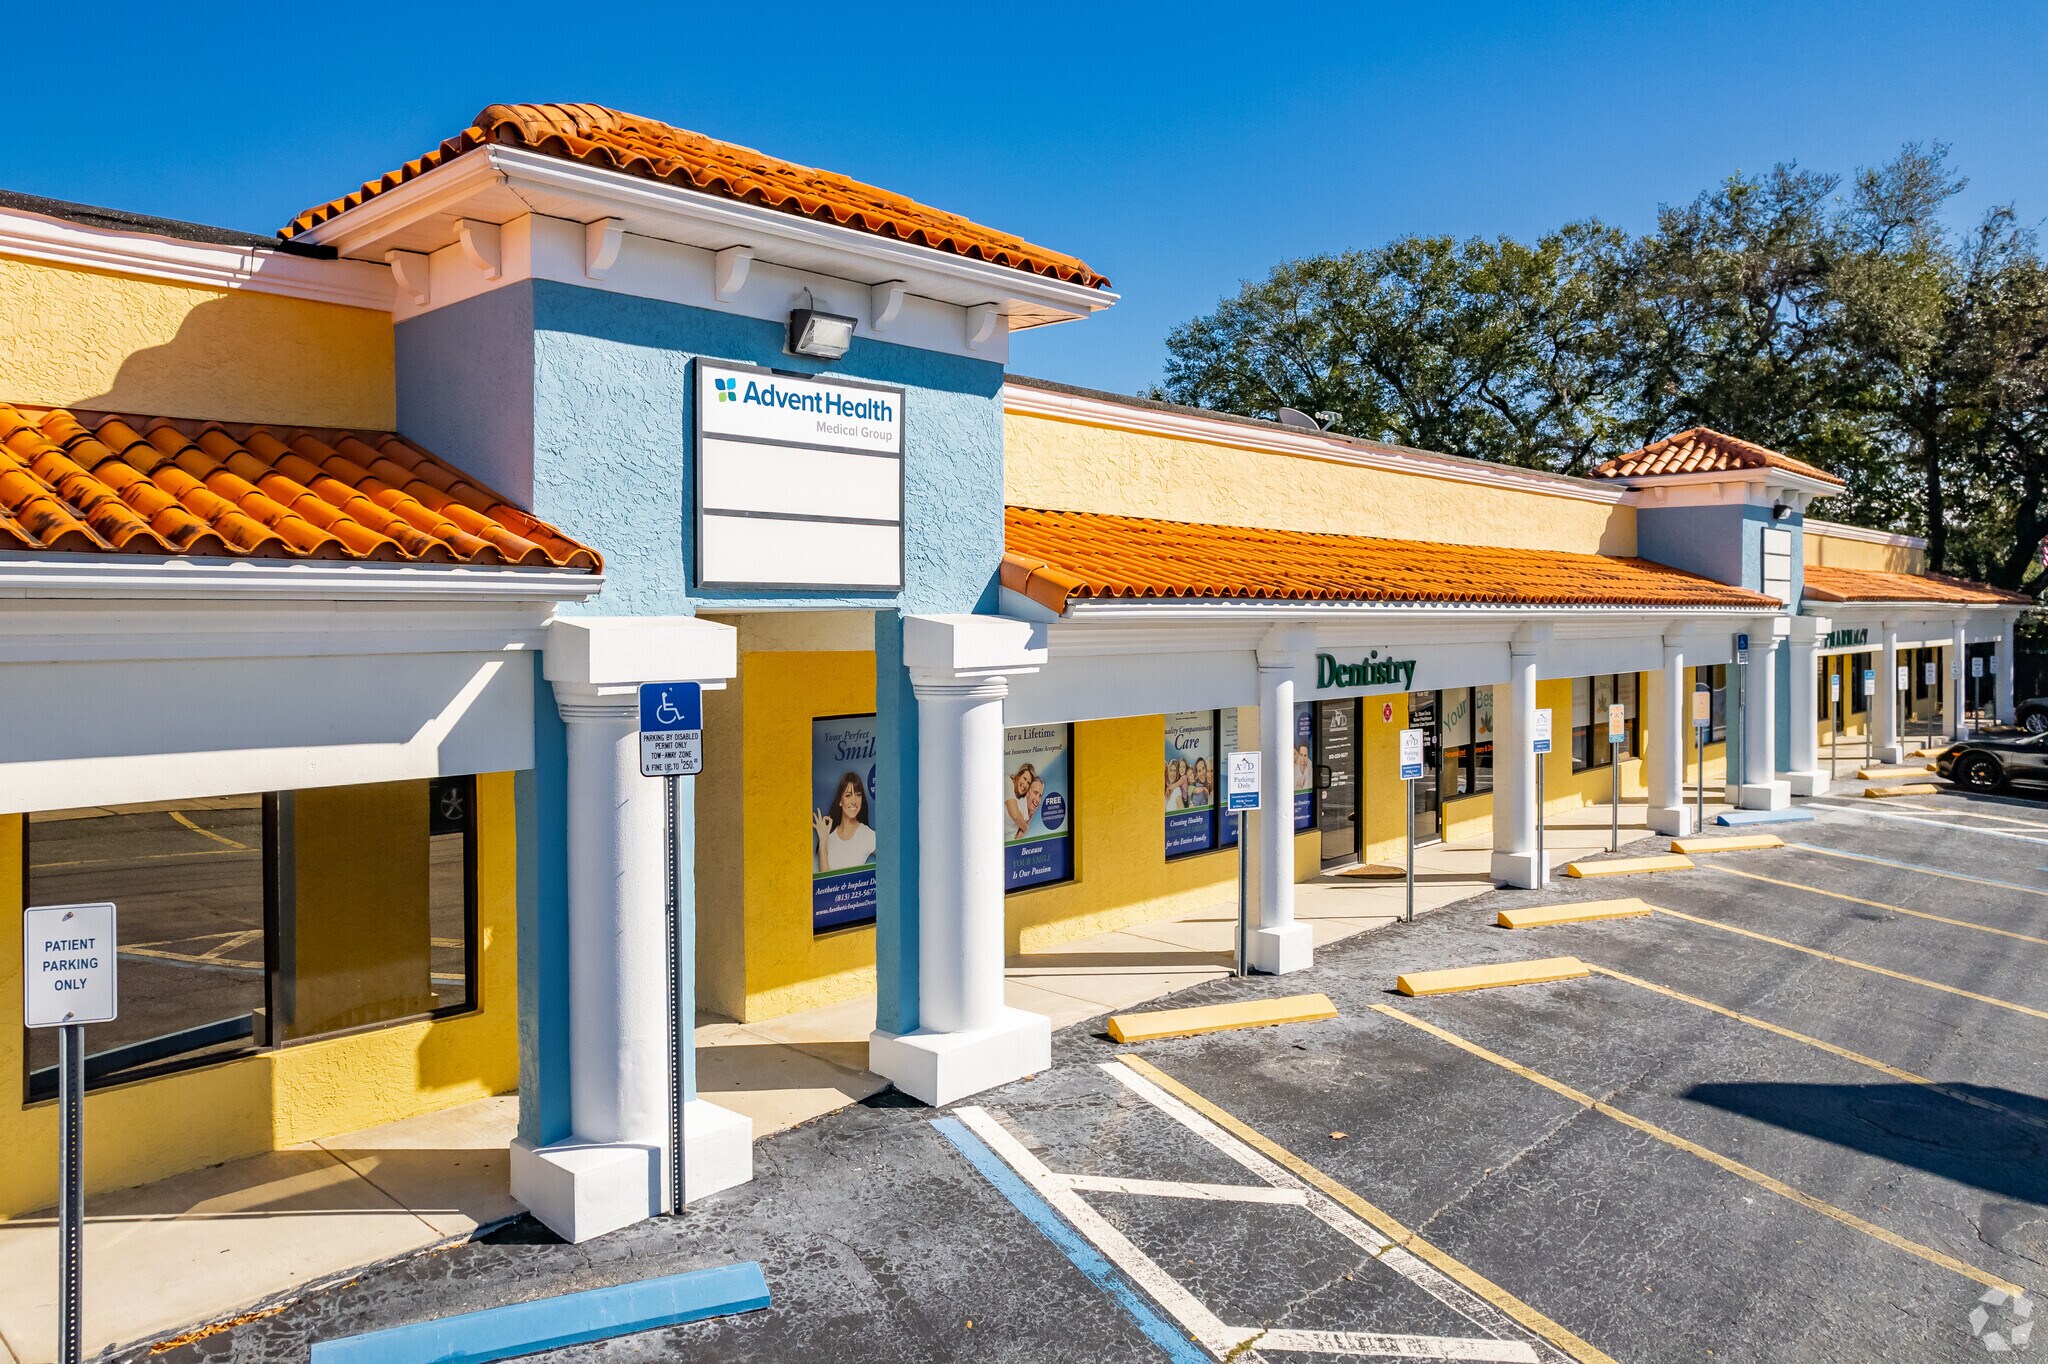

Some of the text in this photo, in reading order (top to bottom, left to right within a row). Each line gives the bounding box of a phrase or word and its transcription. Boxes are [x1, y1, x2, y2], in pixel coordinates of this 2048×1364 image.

[743, 381, 893, 423] AdventHealth
[816, 421, 893, 443] Medical Group
[1315, 650, 1417, 691] Dentistry
[1476, 690, 1493, 709] Bes
[1443, 699, 1466, 732] Your
[643, 734, 664, 742] PARKING
[674, 733, 699, 741] DISABLED
[825, 729, 870, 742] Your Perfect
[1007, 732, 1016, 741] for
[1023, 728, 1055, 740] Lifetime
[655, 741, 687, 750] PERMIT ONLY
[1174, 734, 1200, 750] Care
[651, 751, 692, 759] TOW-AWAY ZONE
[835, 737, 876, 761] Smil
[1045, 797, 1061, 805] FREE
[1021, 847, 1043, 856] Because
[1012, 866, 1052, 879] Is Our Passion
[815, 885, 840, 895] Aesthetic
[848, 880, 869, 890] Implant
[834, 893, 850, 902] (813)
[45, 938, 96, 952] PATIENT
[42, 957, 98, 972] PARKING
[54, 978, 87, 991] ONLY
